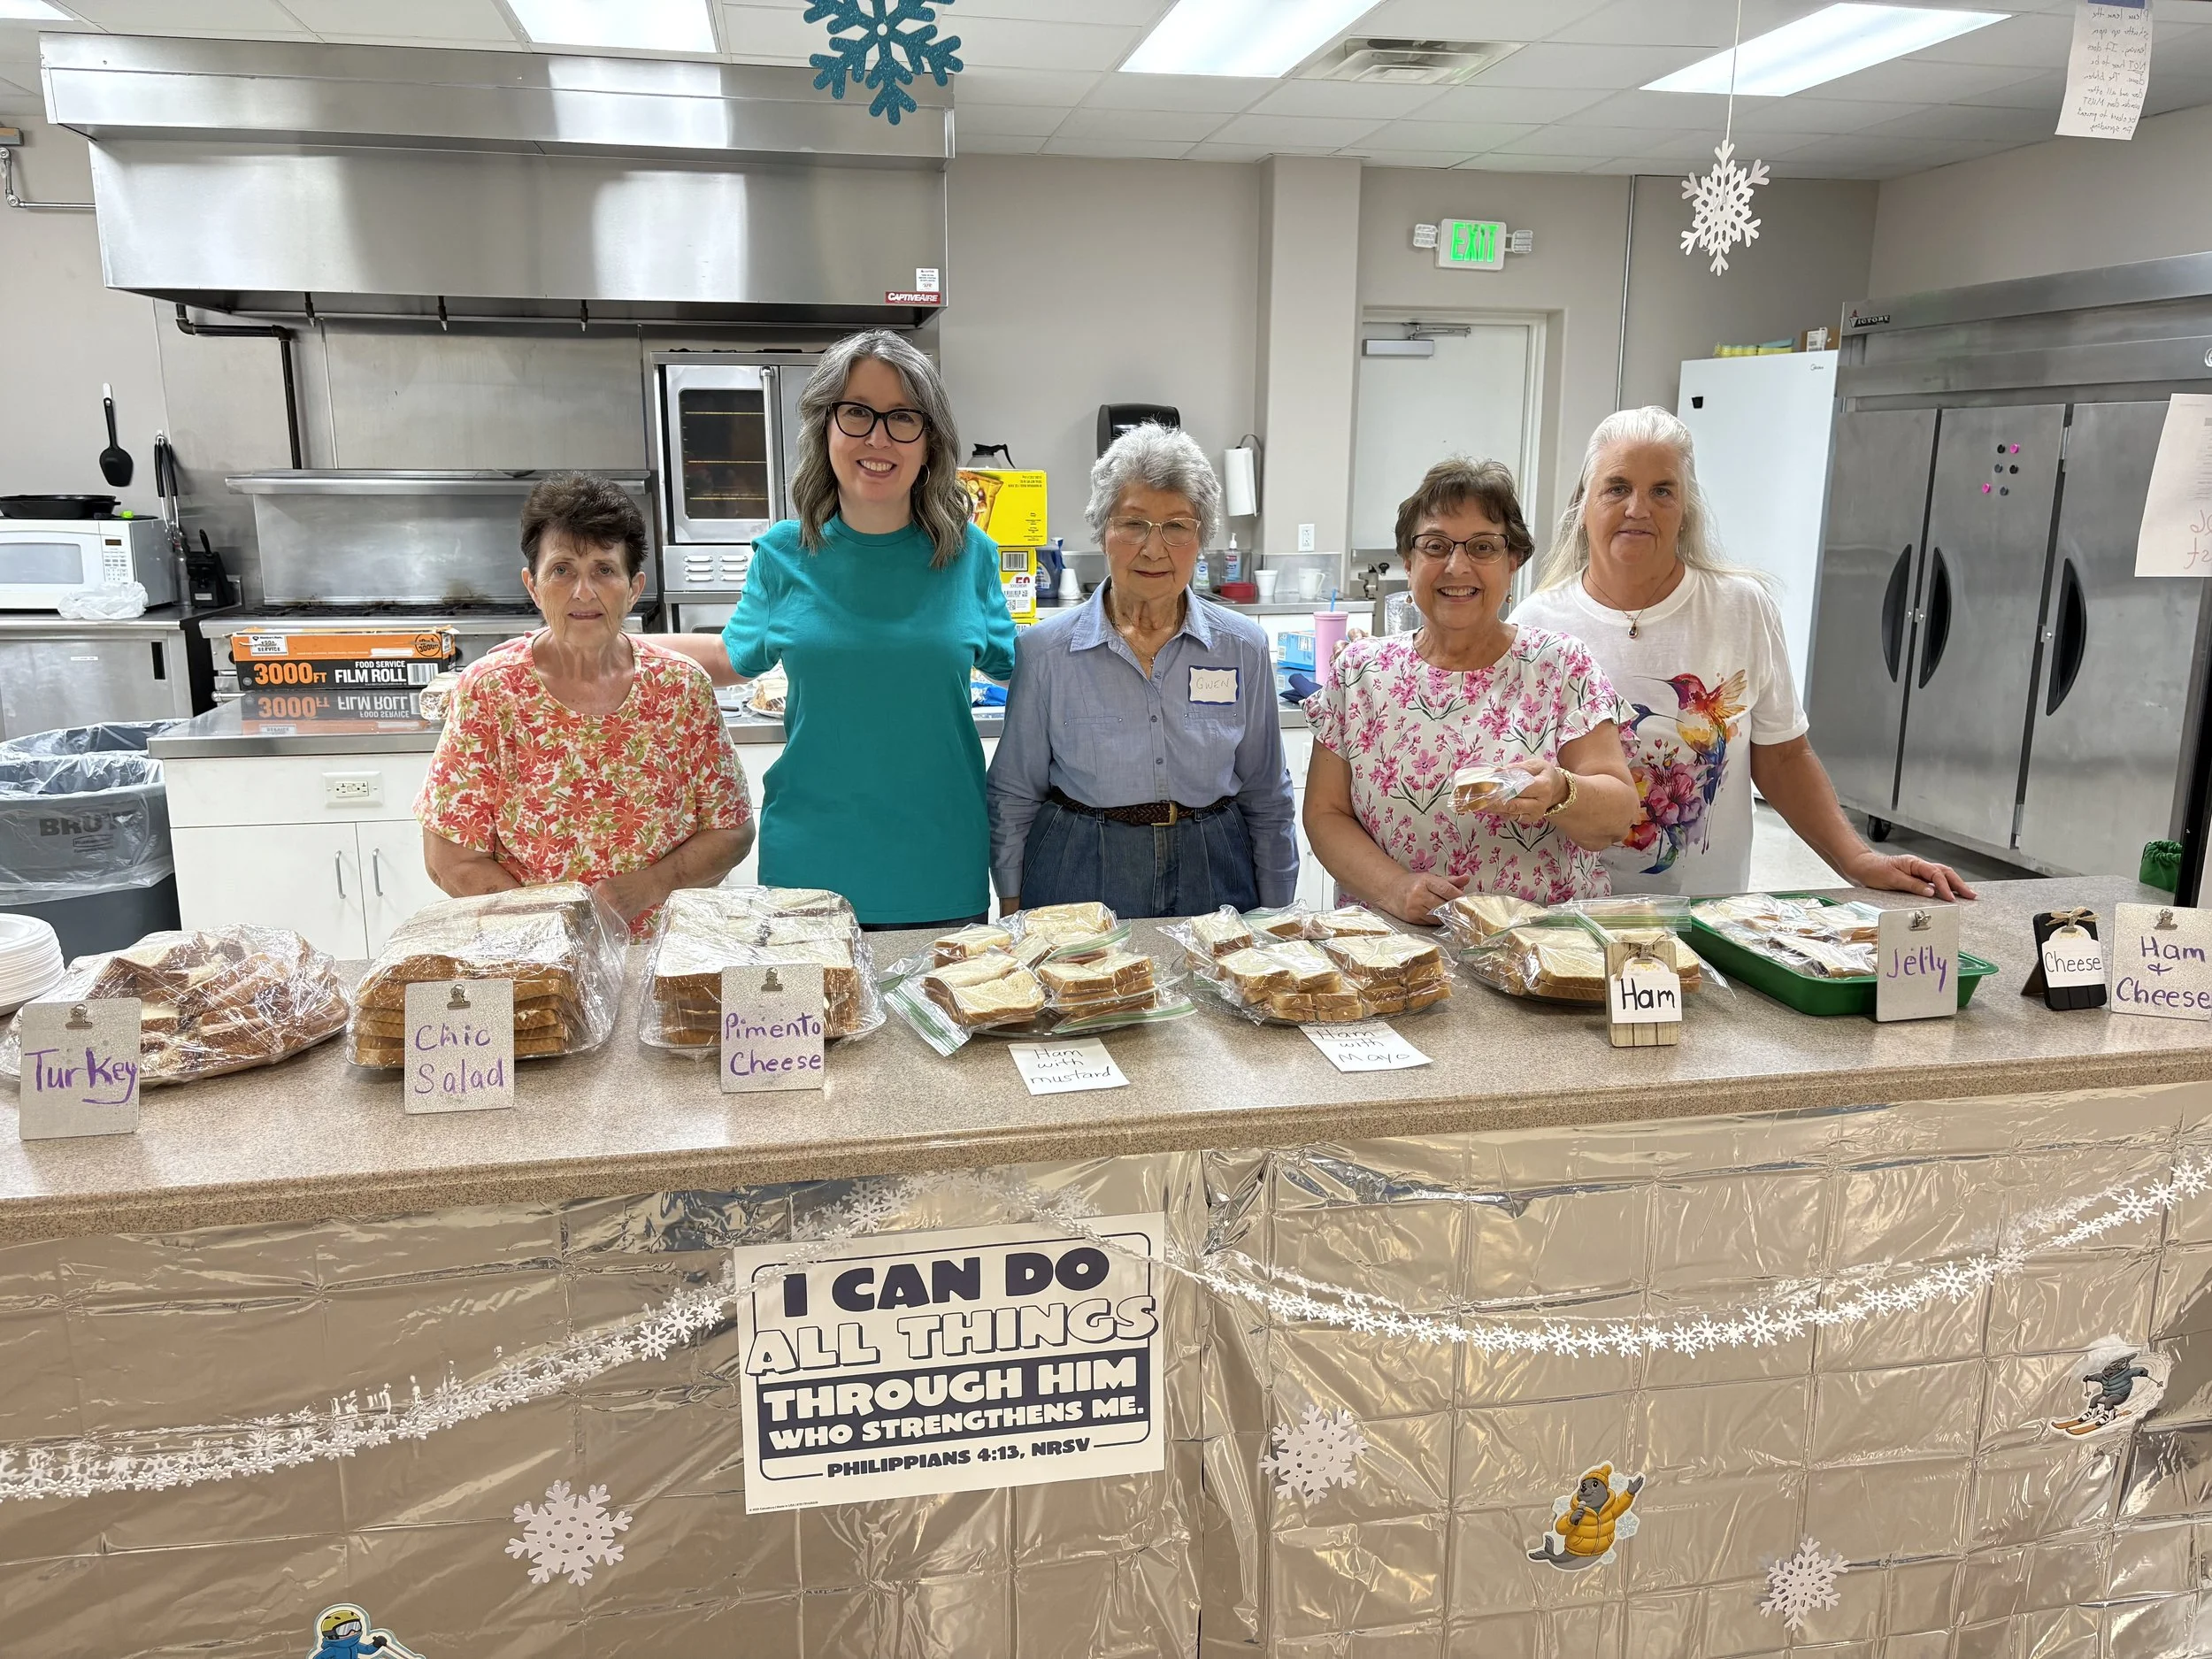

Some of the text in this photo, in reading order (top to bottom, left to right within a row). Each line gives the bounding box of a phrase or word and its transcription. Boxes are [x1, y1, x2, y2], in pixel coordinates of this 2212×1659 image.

[1450, 221, 1499, 263] EXIT
[334, 669, 407, 684] FILM ROLL
[1196, 677, 1230, 690] GWEN
[2045, 951, 2102, 973] Cheese
[2140, 935, 2206, 963] Ham
[1886, 945, 1947, 993] Jelly
[1620, 978, 1675, 1010] Ham
[2116, 976, 2212, 1010] Cheese
[415, 1023, 491, 1051] Chic
[726, 1012, 821, 1041] Pimento
[1316, 1029, 1375, 1041] Ham
[1033, 1048, 1083, 1060] Ham
[1340, 1038, 1385, 1048] with
[730, 1049, 821, 1076] Cheese
[1037, 1057, 1084, 1069] with
[1338, 1053, 1410, 1064] Mayo
[414, 1056, 503, 1094] Salad
[1030, 1065, 1111, 1085] mustard
[784, 1247, 1110, 1317] I CAN DO
[746, 1295, 1158, 1375] ALL THINGS
[763, 1356, 1138, 1422] THROUGH HIM
[768, 1395, 1145, 1451] WHO STRENGTHENS ME.
[826, 1437, 1091, 1479] PHILIPPIANS 4:13, NRSV
